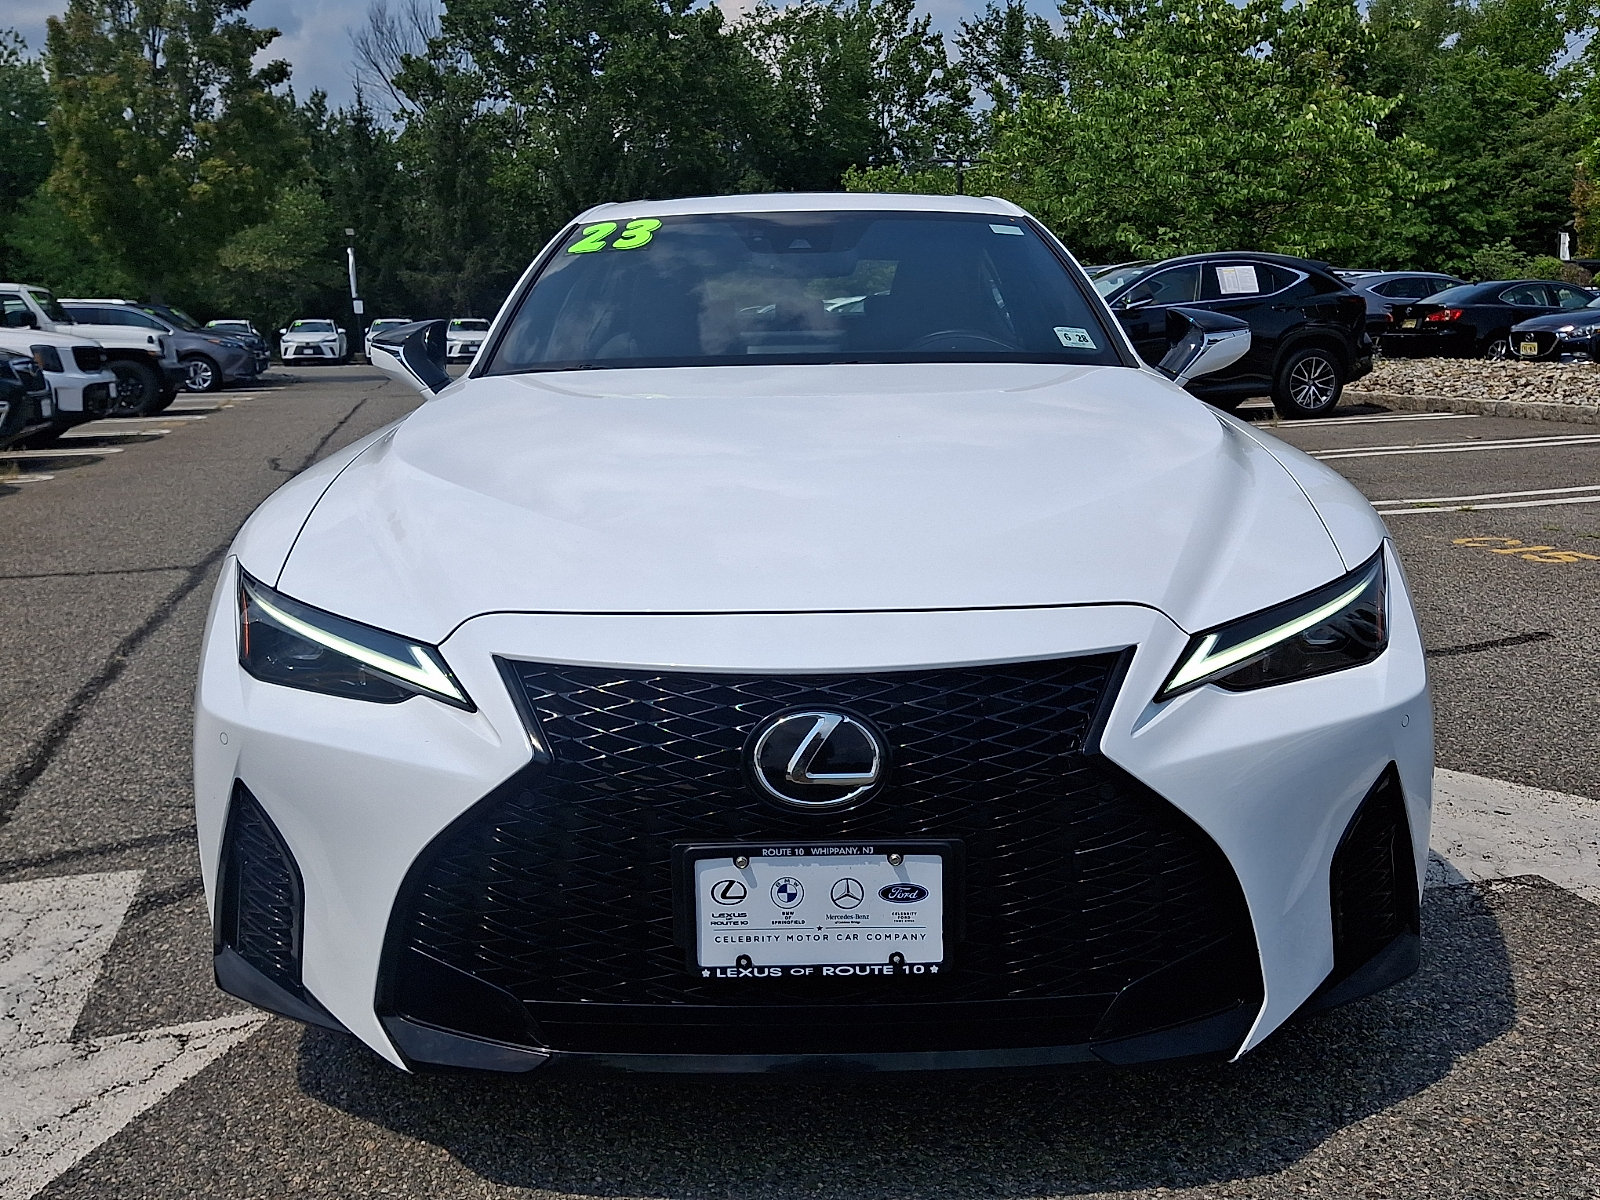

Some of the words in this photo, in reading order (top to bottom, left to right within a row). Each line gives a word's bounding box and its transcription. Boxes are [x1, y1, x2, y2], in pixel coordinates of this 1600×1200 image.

[567, 218, 663, 254] 23
[1063, 333, 1072, 341] 6
[1075, 334, 1089, 342] 28
[762, 848, 792, 856] ROUTE
[794, 848, 805, 856] 10
[811, 847, 860, 856] WHIPPANY,
[862, 846, 874, 854] NJ
[888, 886, 919, 899] Ford
[825, 913, 870, 921] Mercedes-Benz
[714, 935, 780, 943] CELEBRITY
[786, 934, 829, 942] MOTOR
[836, 933, 860, 941] CAR
[866, 933, 927, 941] COMPANY
[716, 967, 783, 978] LEXUS
[790, 967, 814, 976] OF
[822, 965, 894, 976] ROUTE
[902, 964, 925, 975] 10
